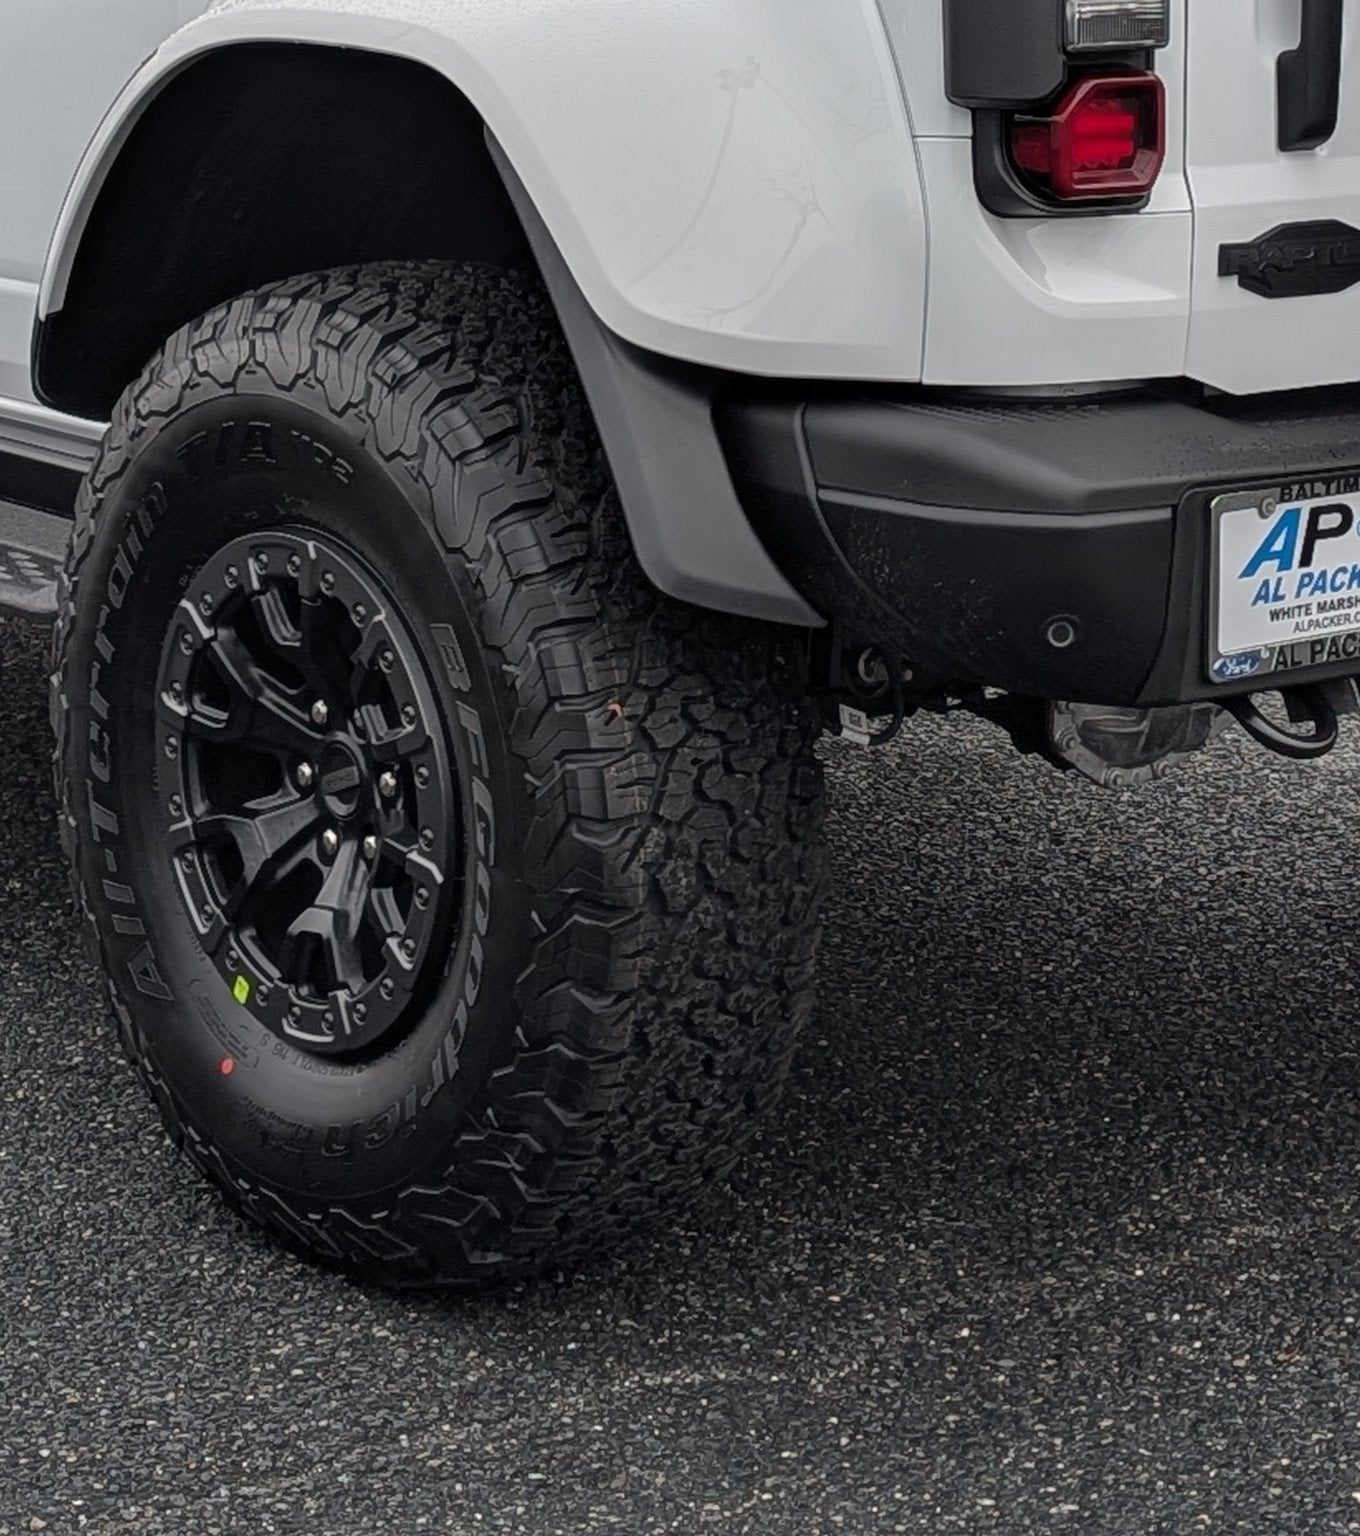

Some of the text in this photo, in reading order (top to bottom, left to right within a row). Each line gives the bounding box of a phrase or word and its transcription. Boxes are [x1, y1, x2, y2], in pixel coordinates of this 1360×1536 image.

[1238, 502, 1354, 579] AP
[1250, 575, 1287, 607] AL
[1269, 602, 1313, 623] WHITE
[1272, 645, 1303, 670] AL
